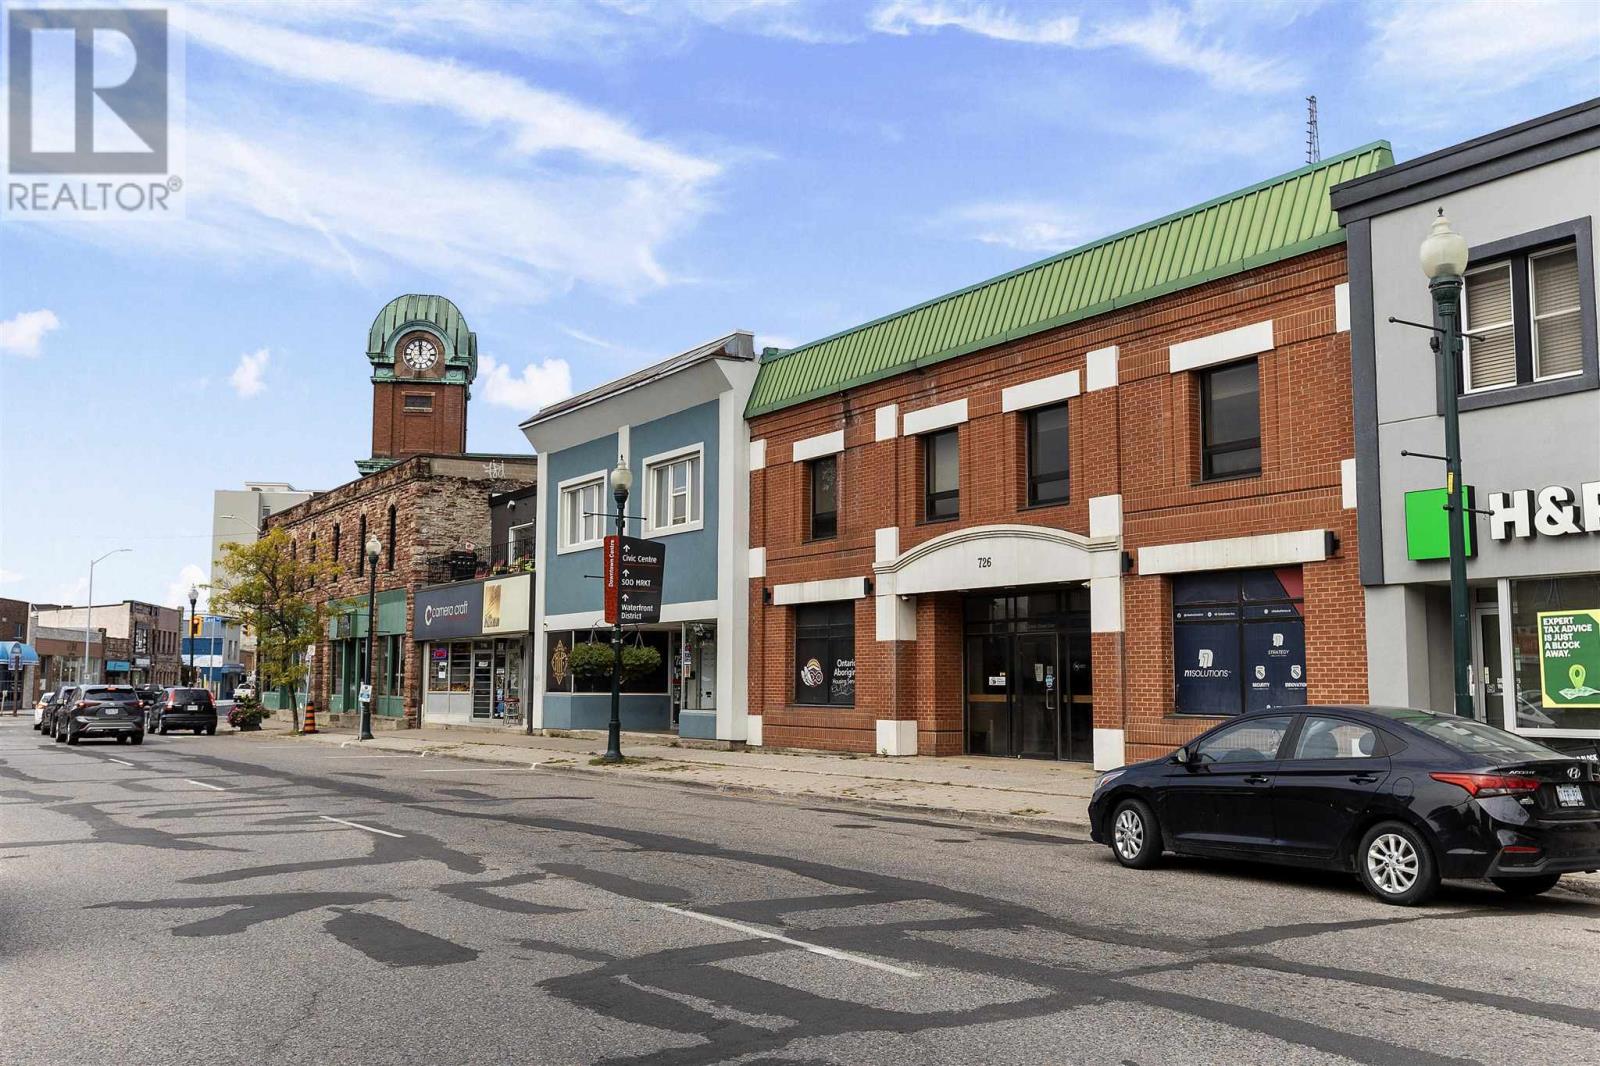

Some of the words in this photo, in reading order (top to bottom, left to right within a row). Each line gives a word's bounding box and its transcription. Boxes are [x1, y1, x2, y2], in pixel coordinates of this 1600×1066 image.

[622, 554, 636, 563] Civic
[637, 556, 657, 564] Centre
[977, 557, 992, 568] 726
[621, 579, 634, 587] SOO
[432, 606, 453, 618] camera
[454, 601, 468, 615] craft
[621, 604, 653, 612] Waterfront
[621, 612, 642, 620] District
[1543, 616, 1574, 625] EXPERT
[1543, 625, 1560, 633] TAX
[1561, 623, 1593, 633] ADVICE
[1544, 634, 1552, 642] IS
[1553, 633, 1573, 641] JUST
[1545, 641, 1551, 649] A
[1551, 641, 1580, 649] BLOCK
[1545, 649, 1571, 658] AWAY.
